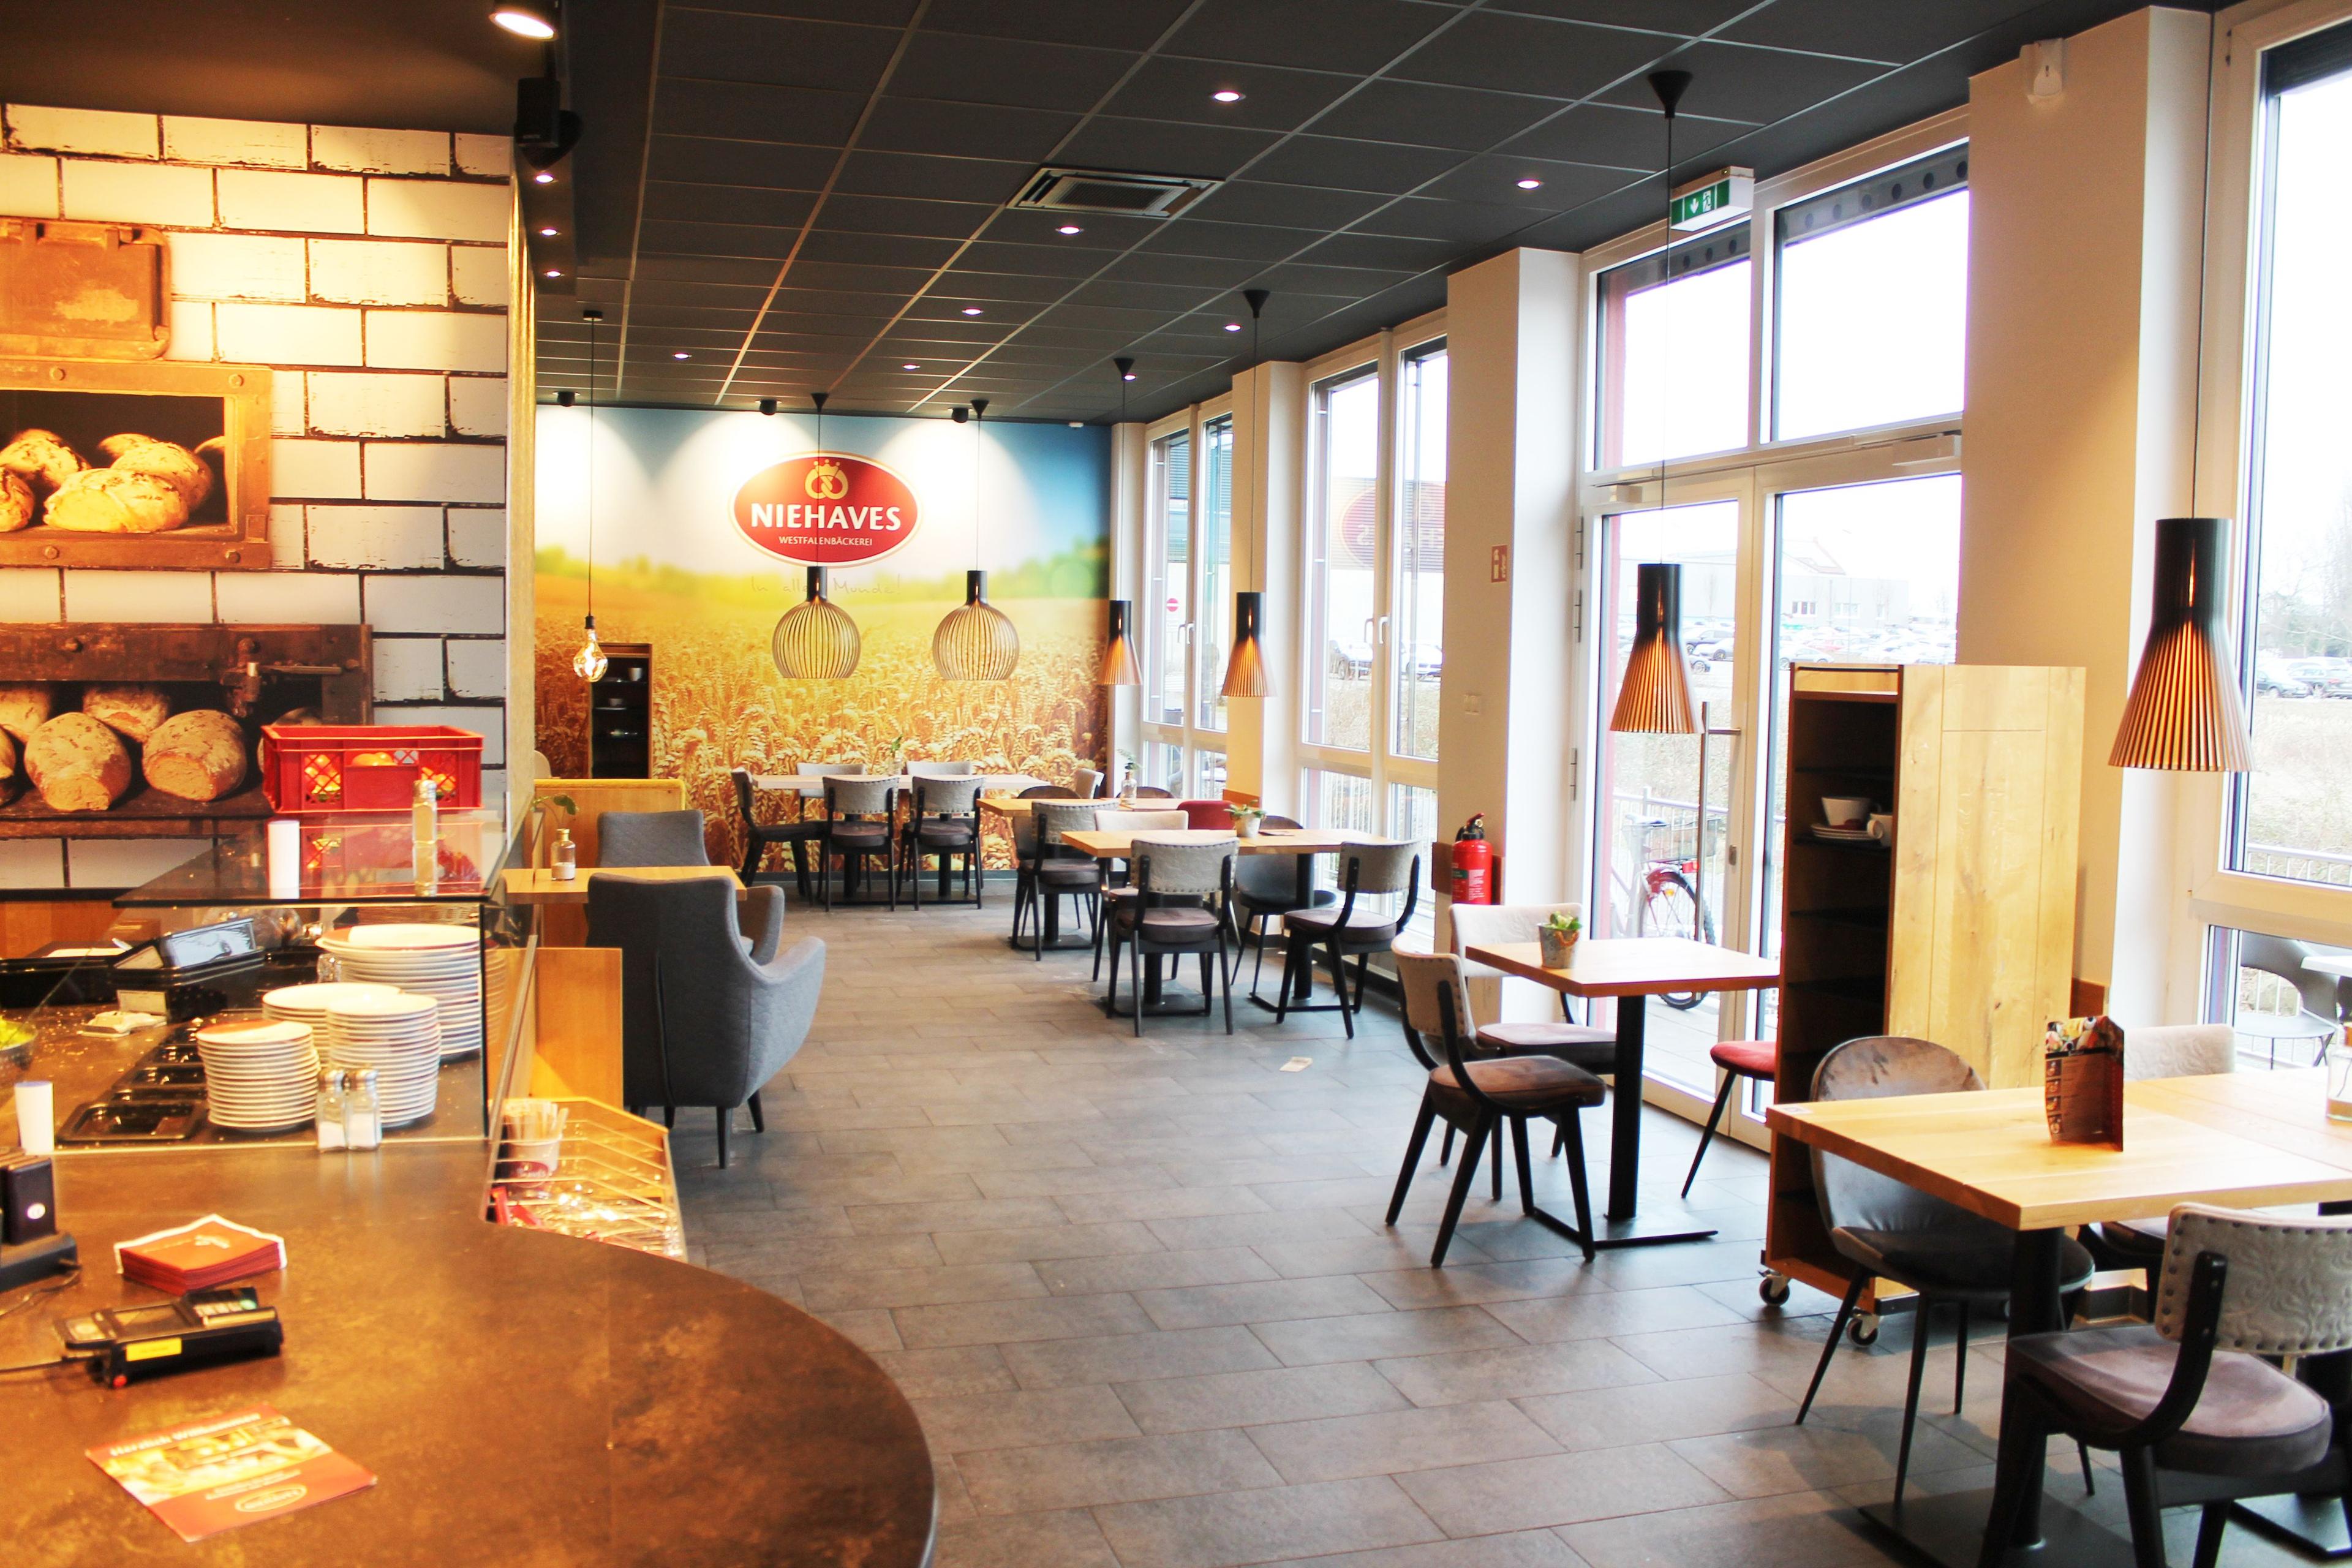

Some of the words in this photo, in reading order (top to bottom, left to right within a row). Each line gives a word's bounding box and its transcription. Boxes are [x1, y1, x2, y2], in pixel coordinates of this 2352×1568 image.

[751, 502, 902, 531] NIEHAVES
[778, 536, 873, 546] WESTFALENBÄCKEREI
[783, 578, 808, 593] alle
